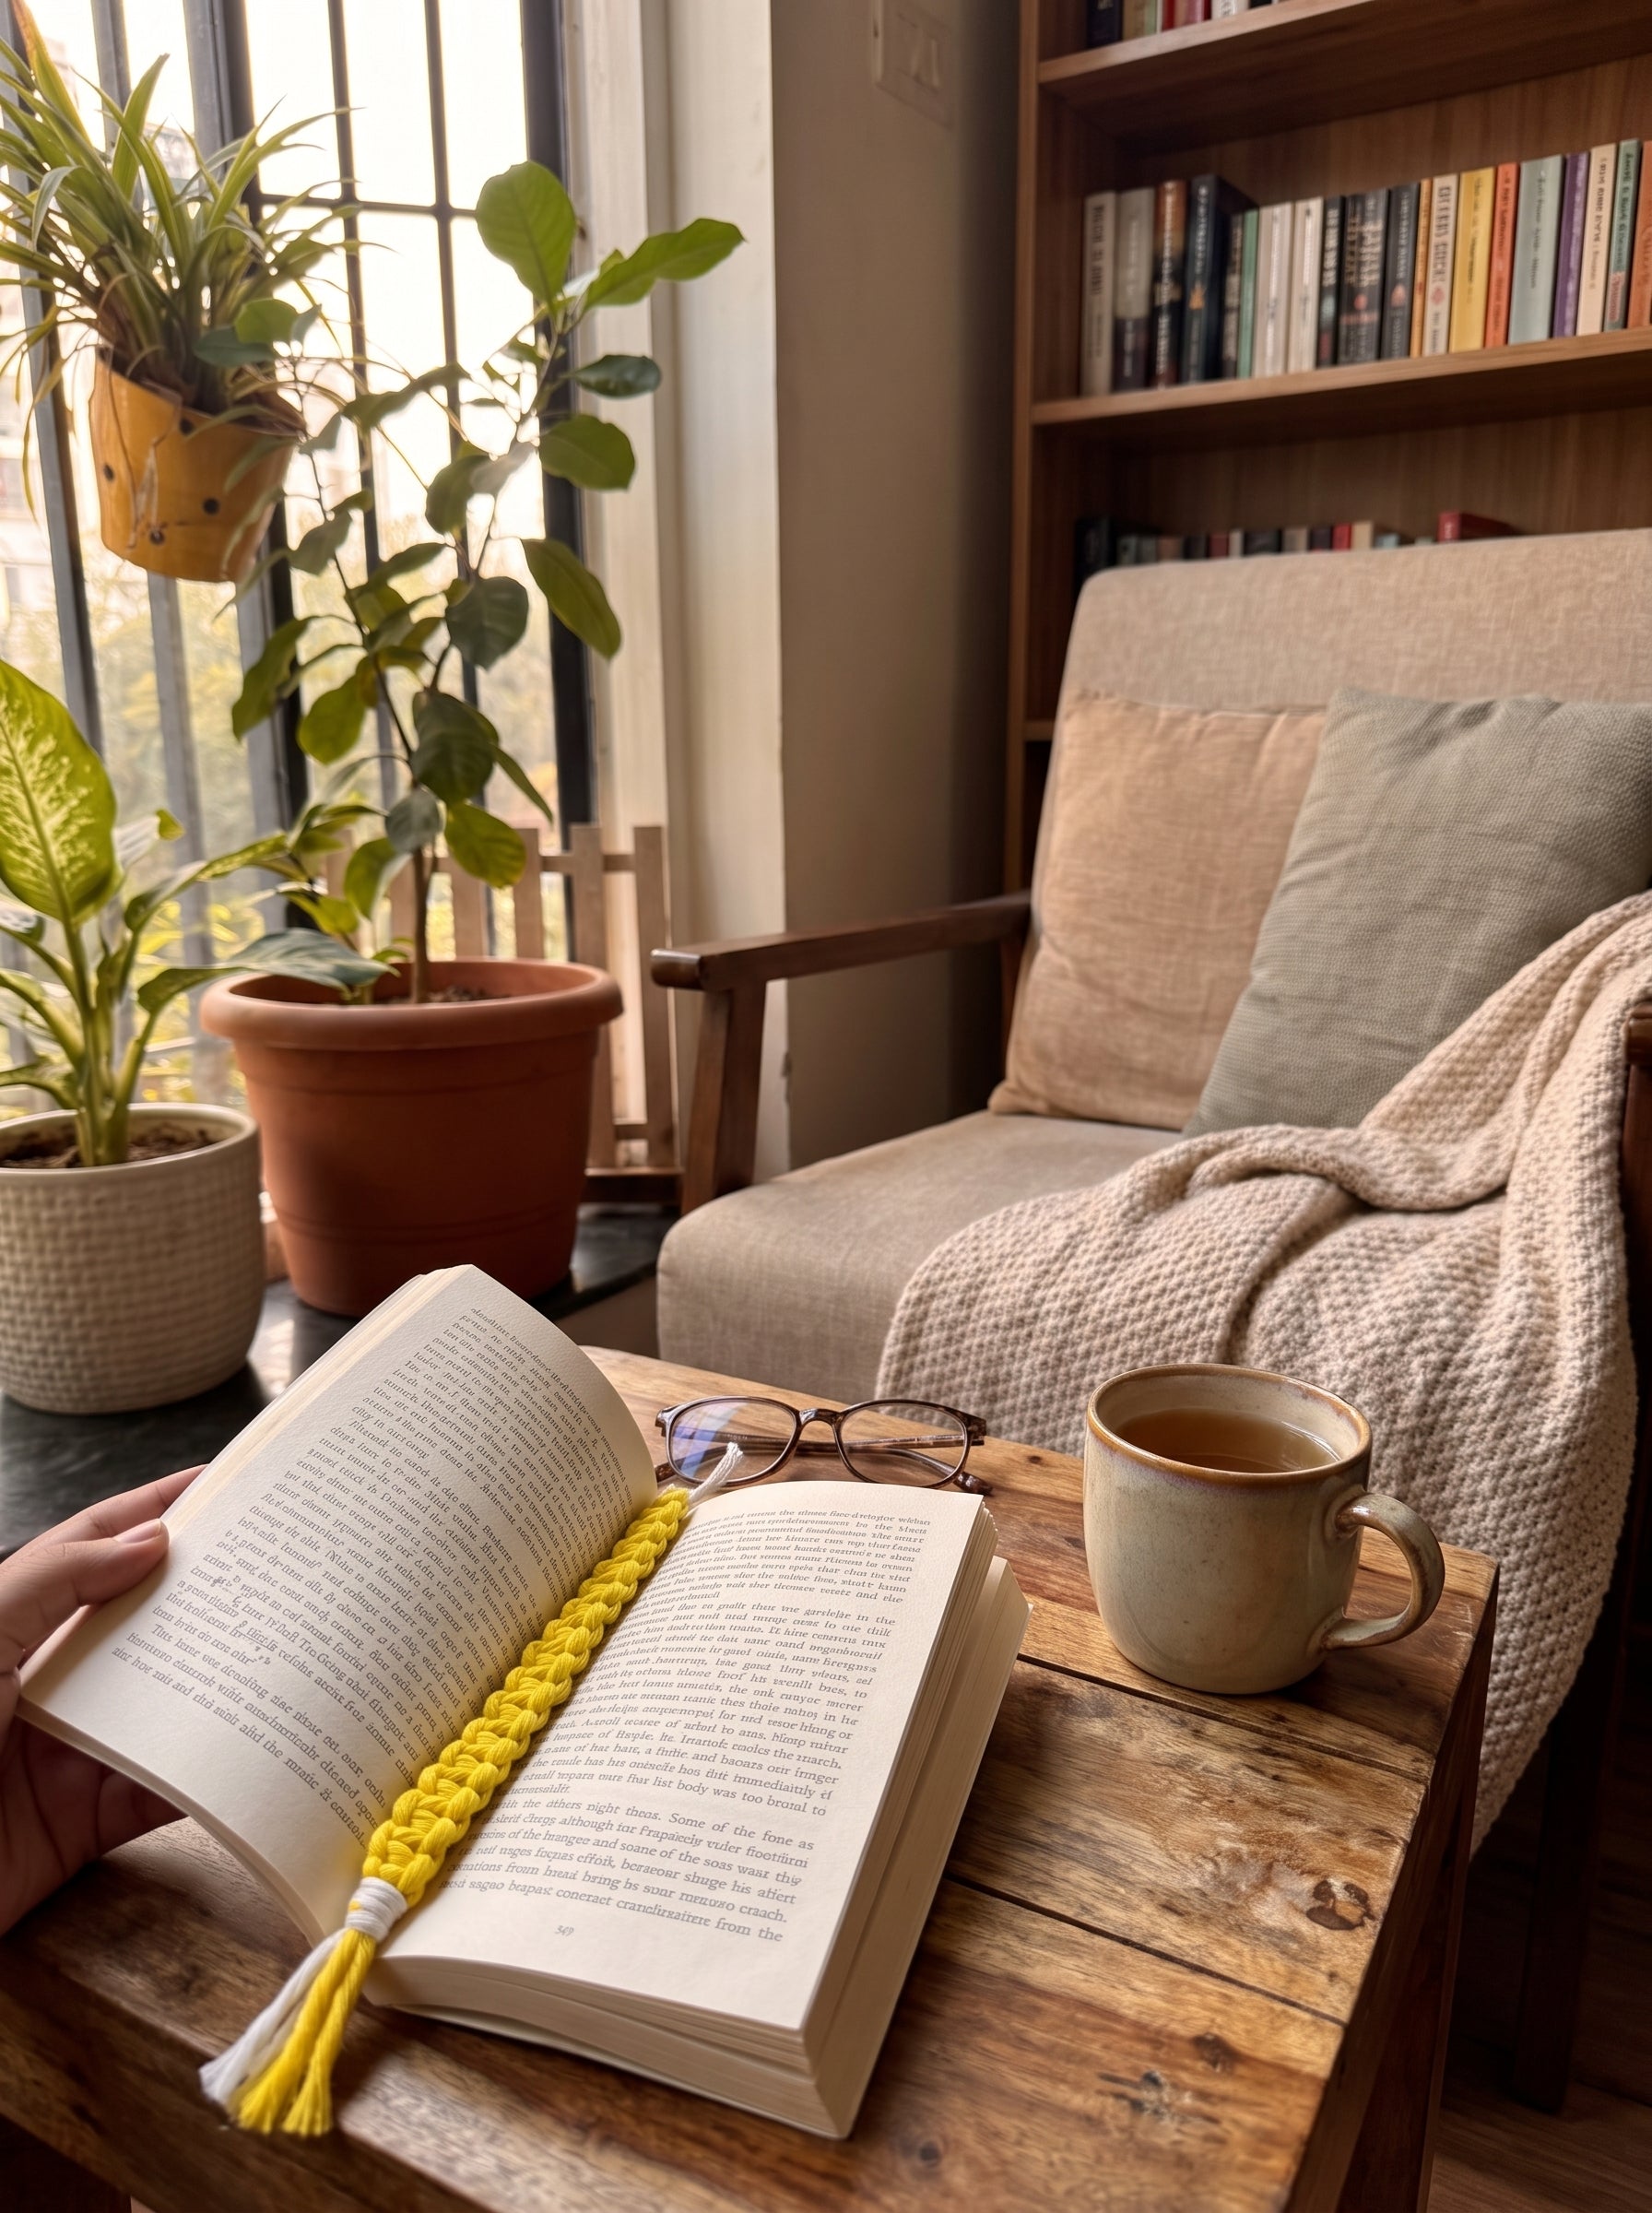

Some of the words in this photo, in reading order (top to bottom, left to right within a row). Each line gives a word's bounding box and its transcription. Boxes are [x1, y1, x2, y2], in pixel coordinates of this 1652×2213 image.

[728, 1685, 748, 1695] the
[823, 1712, 836, 1722] in
[666, 1720, 681, 1728] of
[839, 1731, 854, 1741] or
[692, 1752, 717, 1763] and
[773, 1748, 795, 1761] the
[677, 1778, 710, 1795] body
[713, 1786, 738, 1798] was
[812, 1805, 827, 1817] to
[523, 1798, 541, 1808] the
[668, 1812, 706, 1829] Some
[712, 1821, 730, 1833] of
[733, 1825, 757, 1839] the
[798, 1840, 815, 1851] as
[508, 1829, 524, 1840] of
[523, 1829, 540, 1840] the
[593, 1839, 620, 1849] and
[659, 1848, 678, 1859] of
[678, 1852, 702, 1864] the
[714, 1917, 752, 1935] from
[758, 1927, 784, 1942] the
